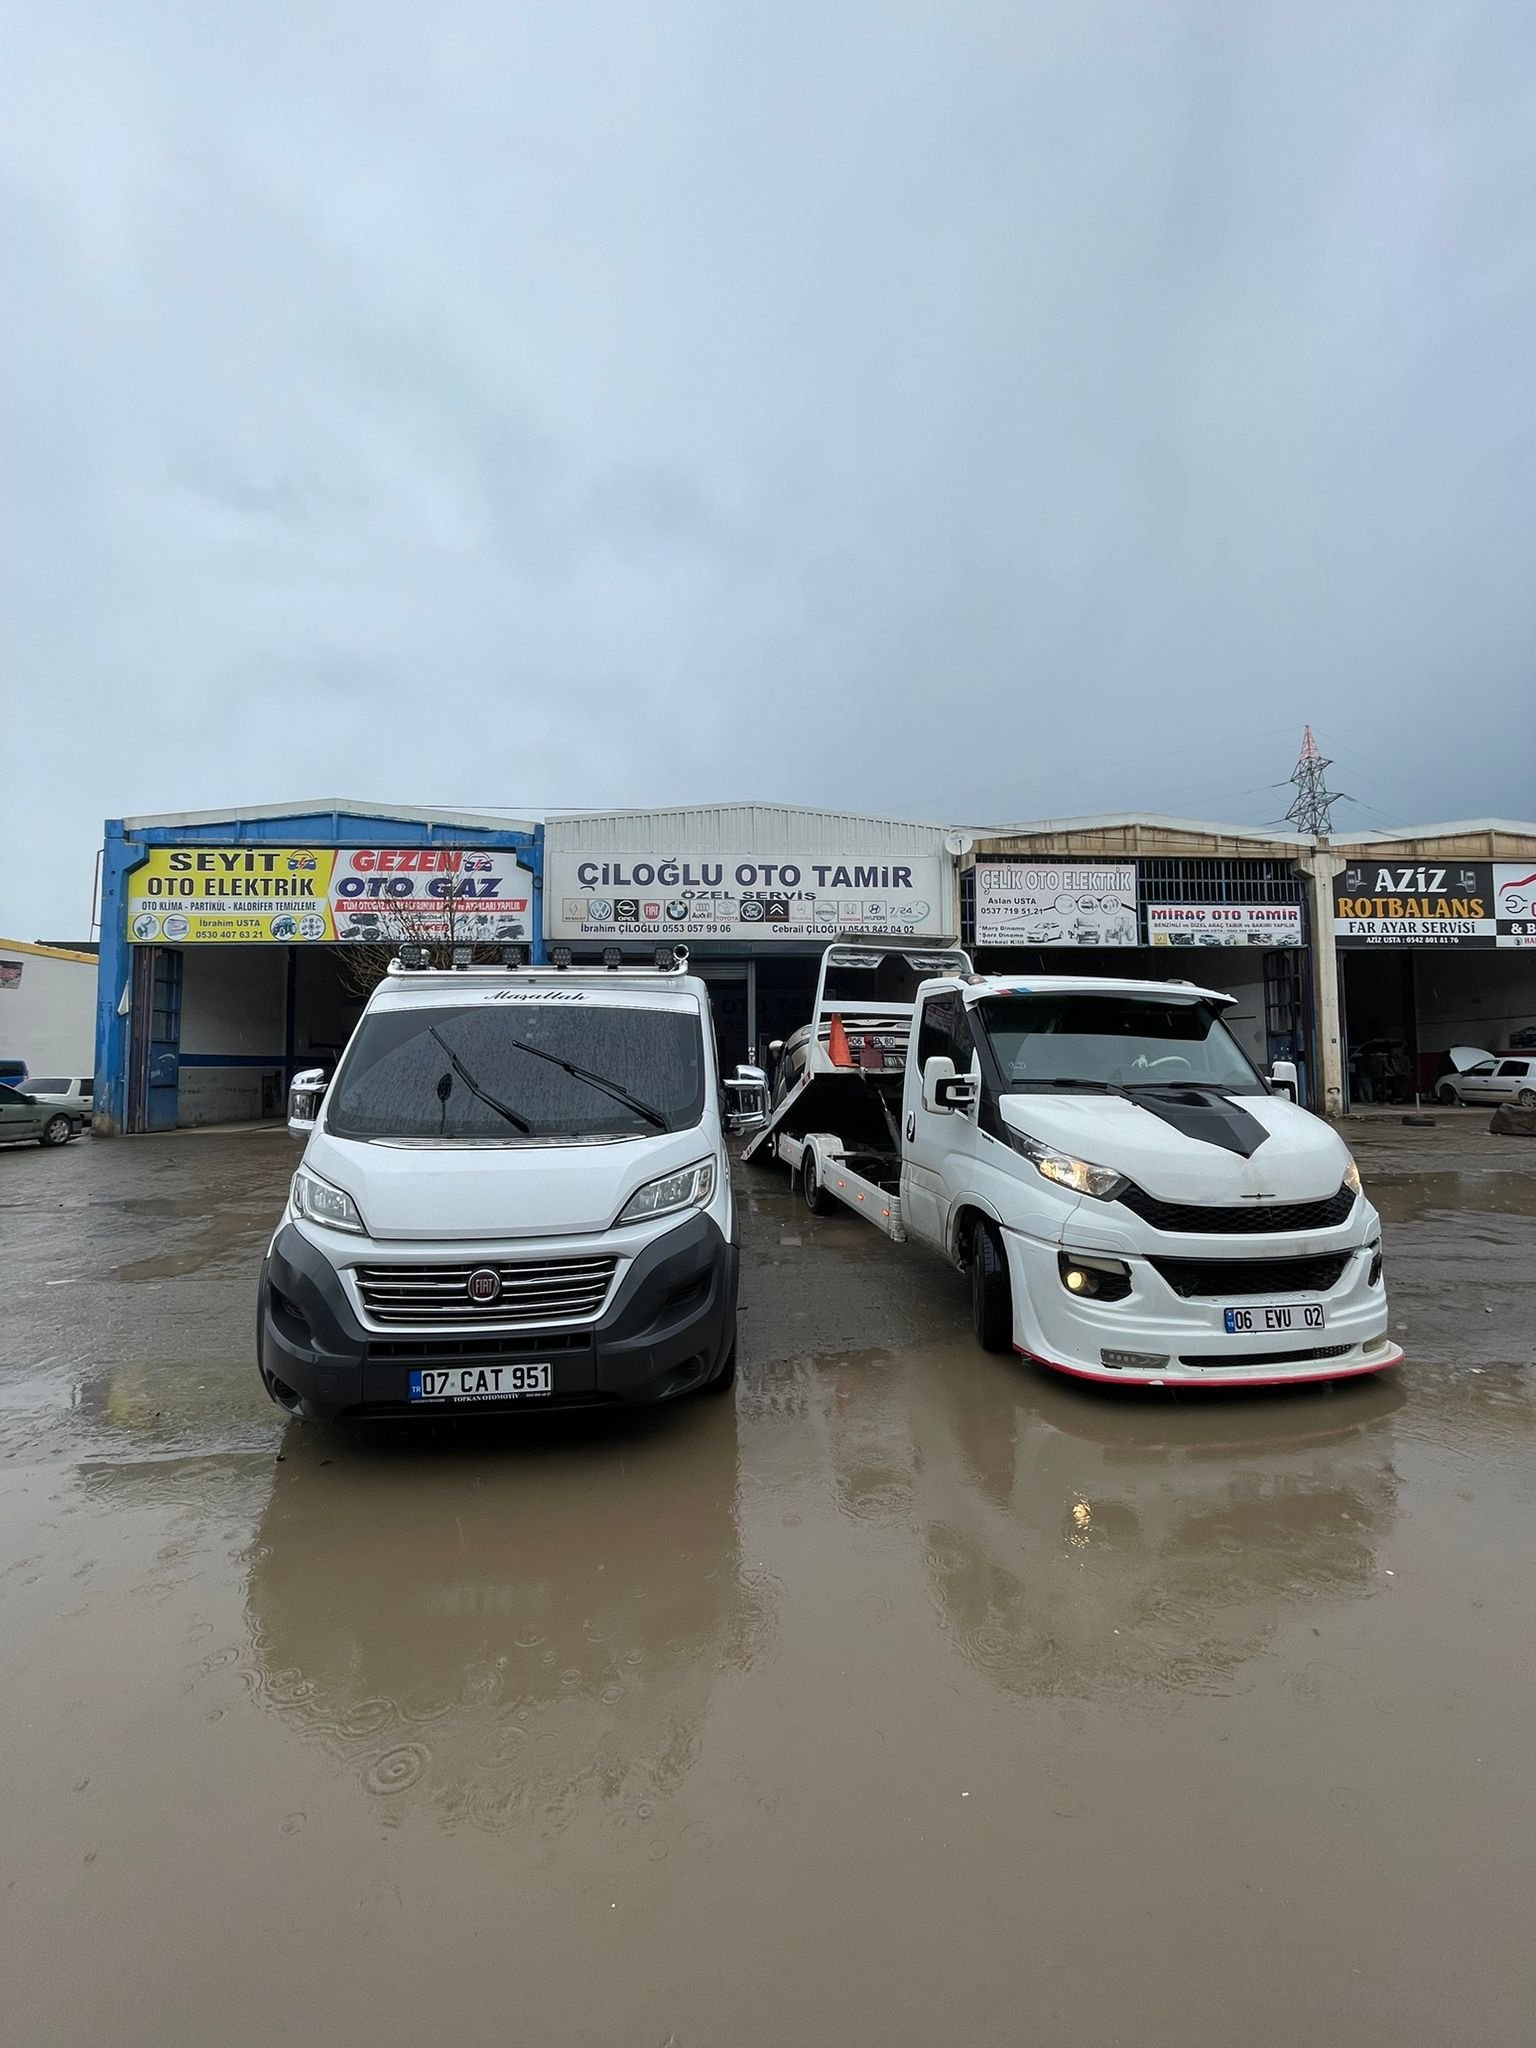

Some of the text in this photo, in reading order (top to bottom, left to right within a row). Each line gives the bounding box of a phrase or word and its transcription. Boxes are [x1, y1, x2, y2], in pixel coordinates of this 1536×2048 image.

[169, 849, 280, 871] SEYİT
[352, 850, 463, 872] GEZEN
[577, 857, 913, 892] ÇİLOĞLU OTO TAMİR
[980, 865, 1132, 895] ÇELİK OTO ELEKTRİK
[1374, 867, 1448, 893] AZİZ
[148, 874, 314, 896] OTO ELEKTRİK
[336, 877, 503, 898] OTO GAZ
[681, 889, 817, 900] ÖZEL SERVİS
[988, 897, 1037, 905] Aslan USTA
[142, 901, 157, 911] OTO
[159, 900, 183, 911] KLİMA
[190, 900, 226, 911] PARTİKÜL
[233, 900, 273, 911] KALORİFER
[276, 900, 316, 911] TEMİZLEME
[1337, 897, 1485, 918] ROTBALANS
[1151, 908, 1298, 922] MİRAÇ OTO TAMİR
[200, 919, 261, 928] İbrahim USTA
[581, 922, 731, 935] İbrahim ÇİLOĞLU 0553 057 99 06
[772, 924, 804, 933] Cebrail
[872, 925, 888, 933] 842
[891, 925, 902, 933] 04
[904, 925, 914, 934] 02
[1349, 921, 1476, 934] FAR AYAR SERVİSİ
[1511, 923, 1522, 934] &
[196, 931, 263, 939] 0530 407 63 21
[475, 1278, 493, 1293] FIAT
[1235, 1311, 1252, 1329] 06
[1265, 1309, 1292, 1328] EVU
[1304, 1308, 1322, 1326] 02
[422, 1372, 449, 1395] 07
[460, 1369, 503, 1393] CAT
[512, 1366, 549, 1389] 951
